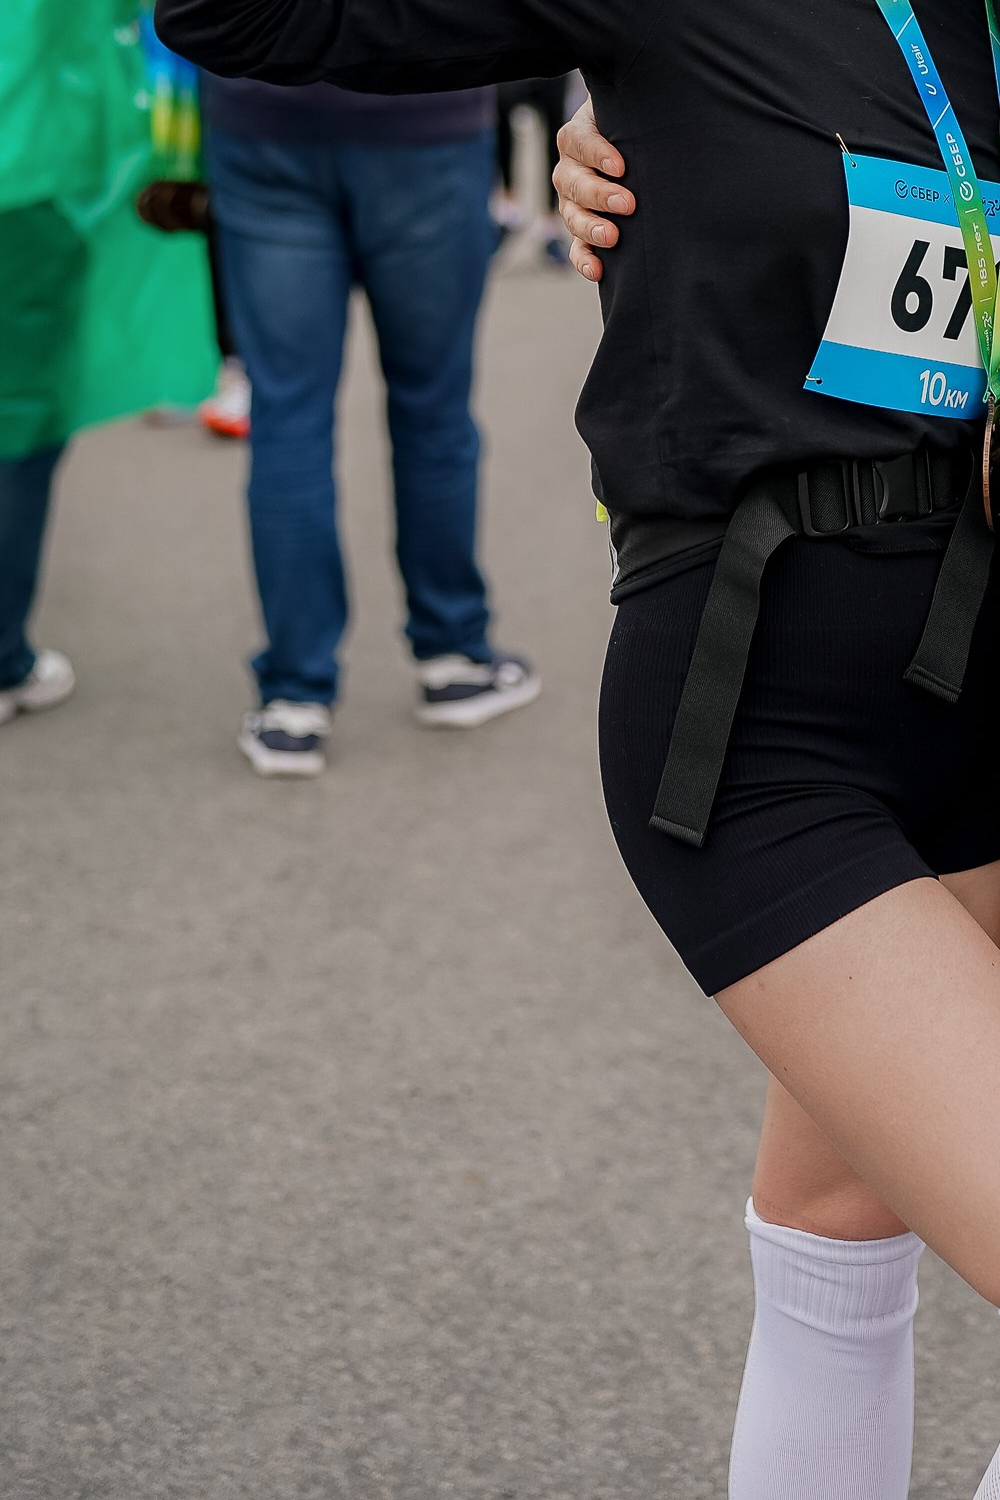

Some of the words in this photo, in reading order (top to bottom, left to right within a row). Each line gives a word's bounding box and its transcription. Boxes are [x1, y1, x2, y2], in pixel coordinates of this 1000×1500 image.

[910, 43, 929, 75] Utair
[945, 132, 966, 177] СБЕР
[910, 186, 940, 204] СБЕР
[972, 222, 984, 253] лет
[977, 257, 988, 287] 185
[890, 239, 1000, 341] 67
